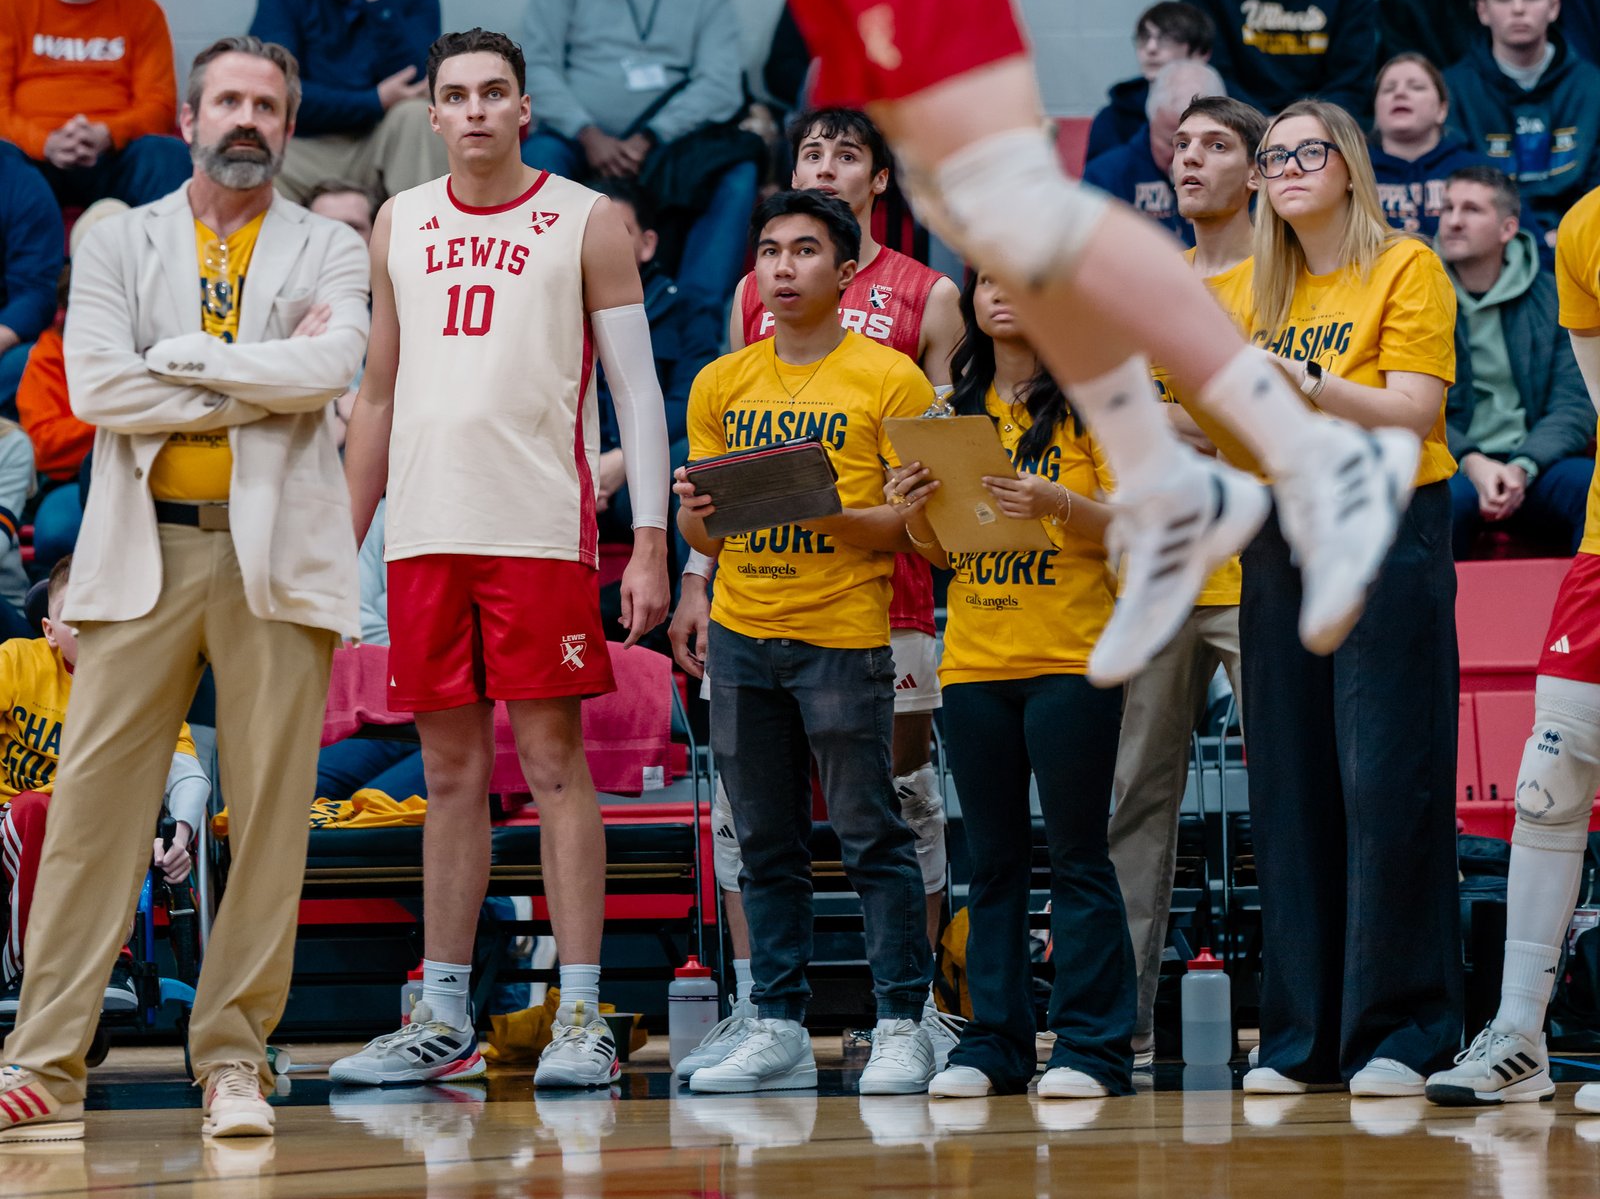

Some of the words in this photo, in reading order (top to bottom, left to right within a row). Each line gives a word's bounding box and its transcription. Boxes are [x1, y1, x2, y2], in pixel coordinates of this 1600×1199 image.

[33, 33, 126, 62] WAVES
[426, 236, 530, 276] LEWIS
[872, 283, 893, 292] LEWIS
[443, 284, 495, 337] 10
[723, 409, 848, 451] CHASING
[737, 562, 757, 575] cal's
[758, 563, 797, 580] angels
[976, 550, 1060, 586] CURE
[965, 593, 982, 606] cal's
[982, 595, 1019, 612] angels
[562, 633, 586, 643] LEWIS
